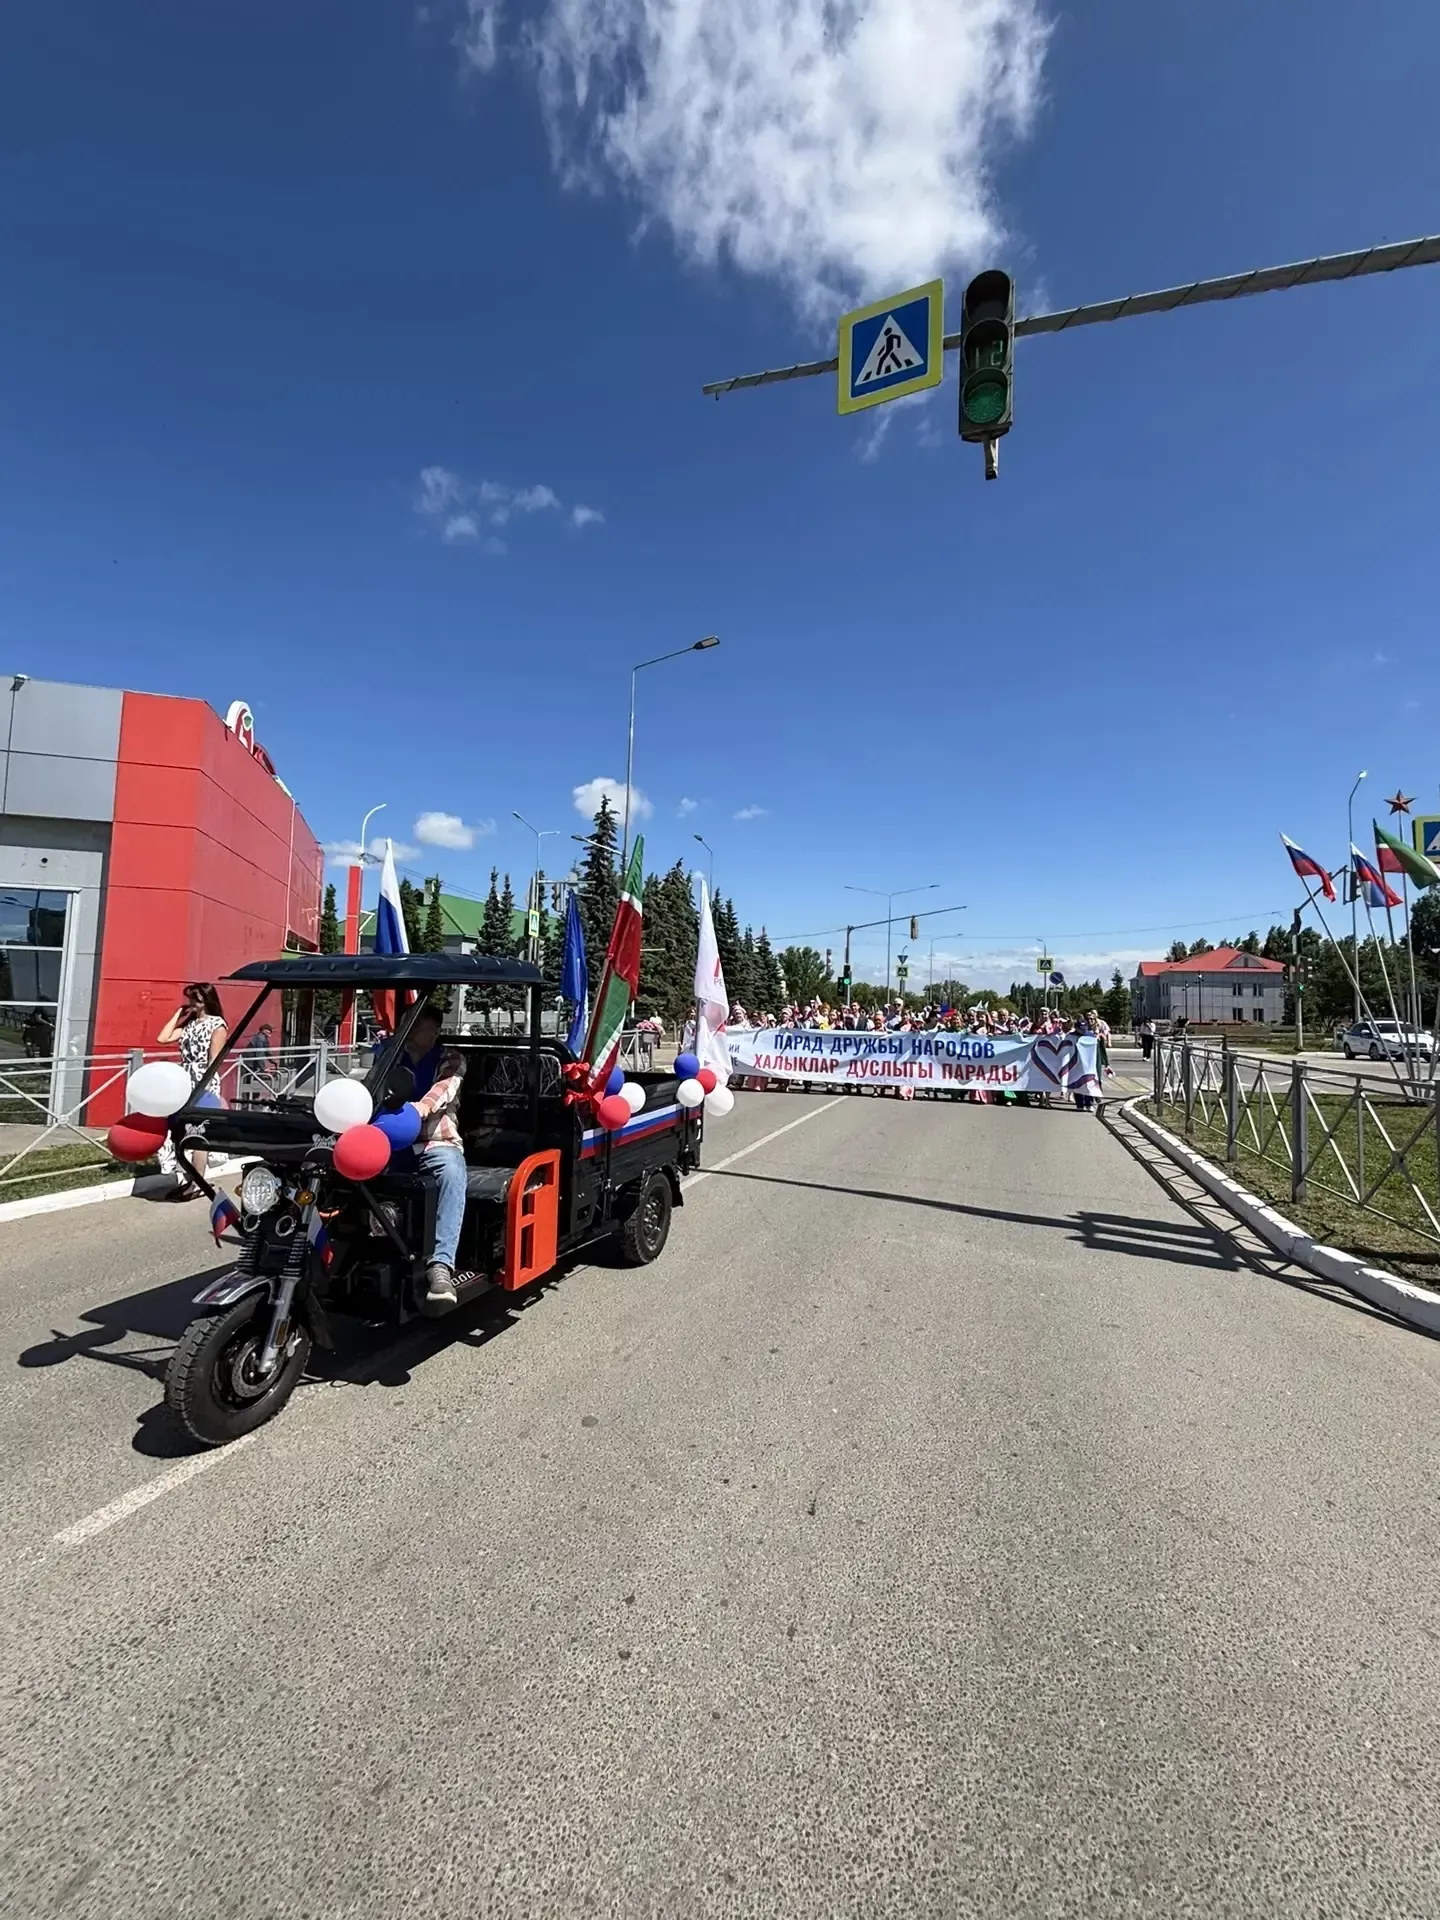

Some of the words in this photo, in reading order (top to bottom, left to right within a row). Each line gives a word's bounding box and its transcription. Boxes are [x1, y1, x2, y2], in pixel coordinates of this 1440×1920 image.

[975, 339, 1003, 369] 12
[774, 1035, 823, 1054] ПАРАД
[830, 1037, 902, 1056] ДРУЖБЫ
[912, 1039, 995, 1060] НАРОДОВ
[754, 1054, 839, 1073] ХАЛЫКЛАР
[847, 1060, 932, 1080] ДУСЛЫГЫ
[942, 1063, 1018, 1084] ПАРАДЫ
